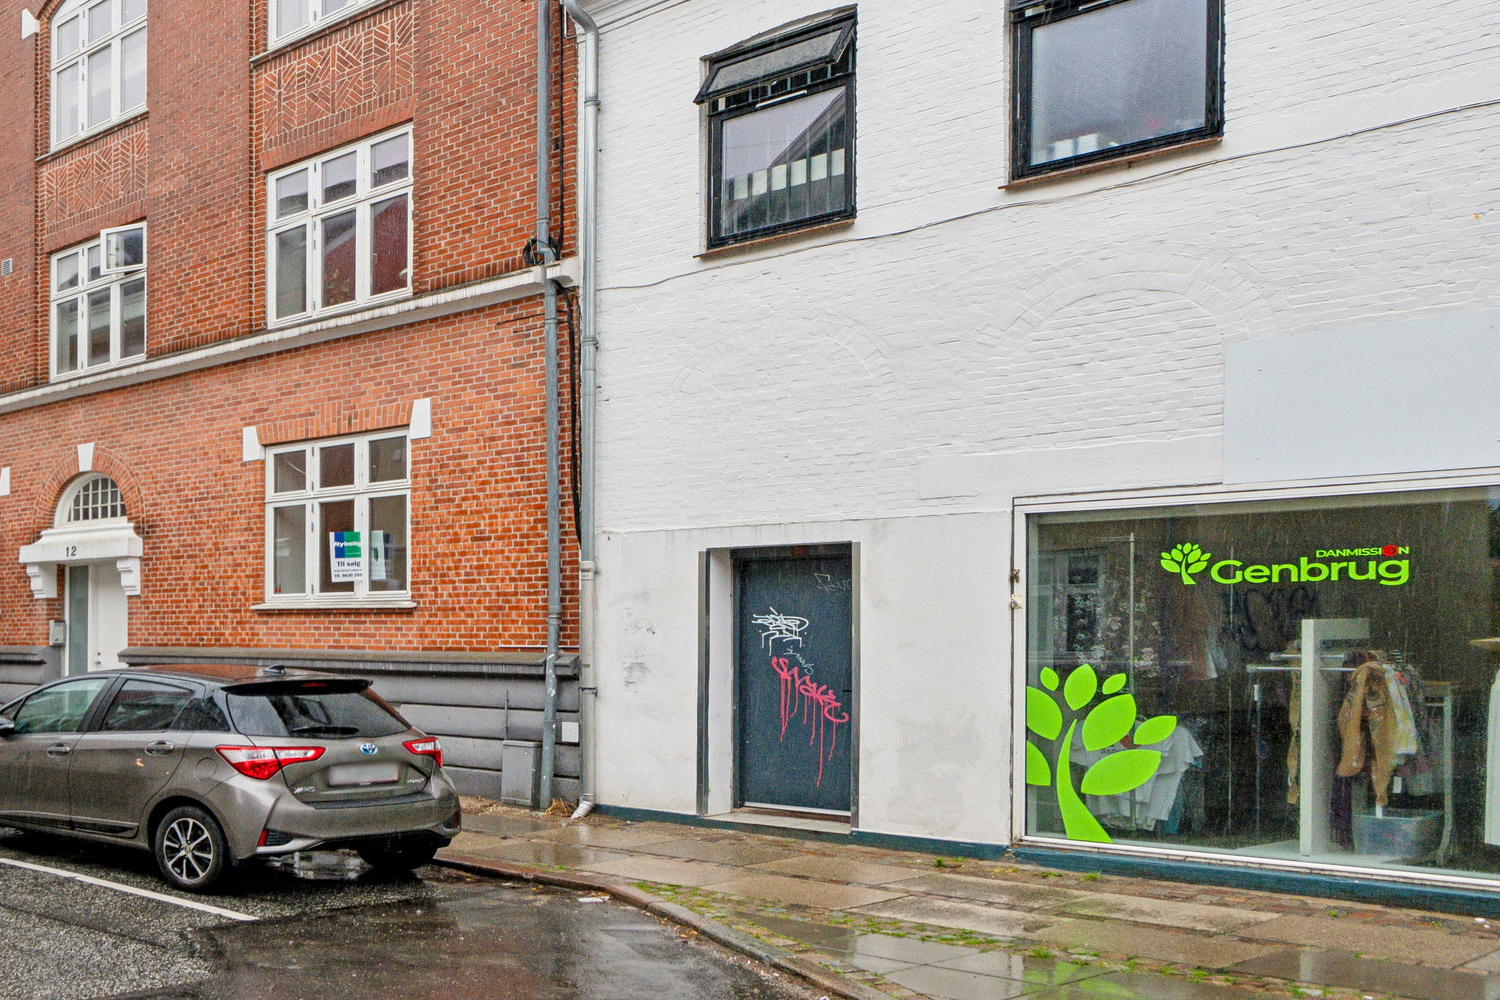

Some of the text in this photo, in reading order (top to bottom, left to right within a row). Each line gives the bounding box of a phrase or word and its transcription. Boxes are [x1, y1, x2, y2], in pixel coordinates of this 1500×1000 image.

[65, 545, 77, 557] 12
[1315, 545, 1410, 558] DANMISSION
[1210, 556, 1410, 586] Genbrug
